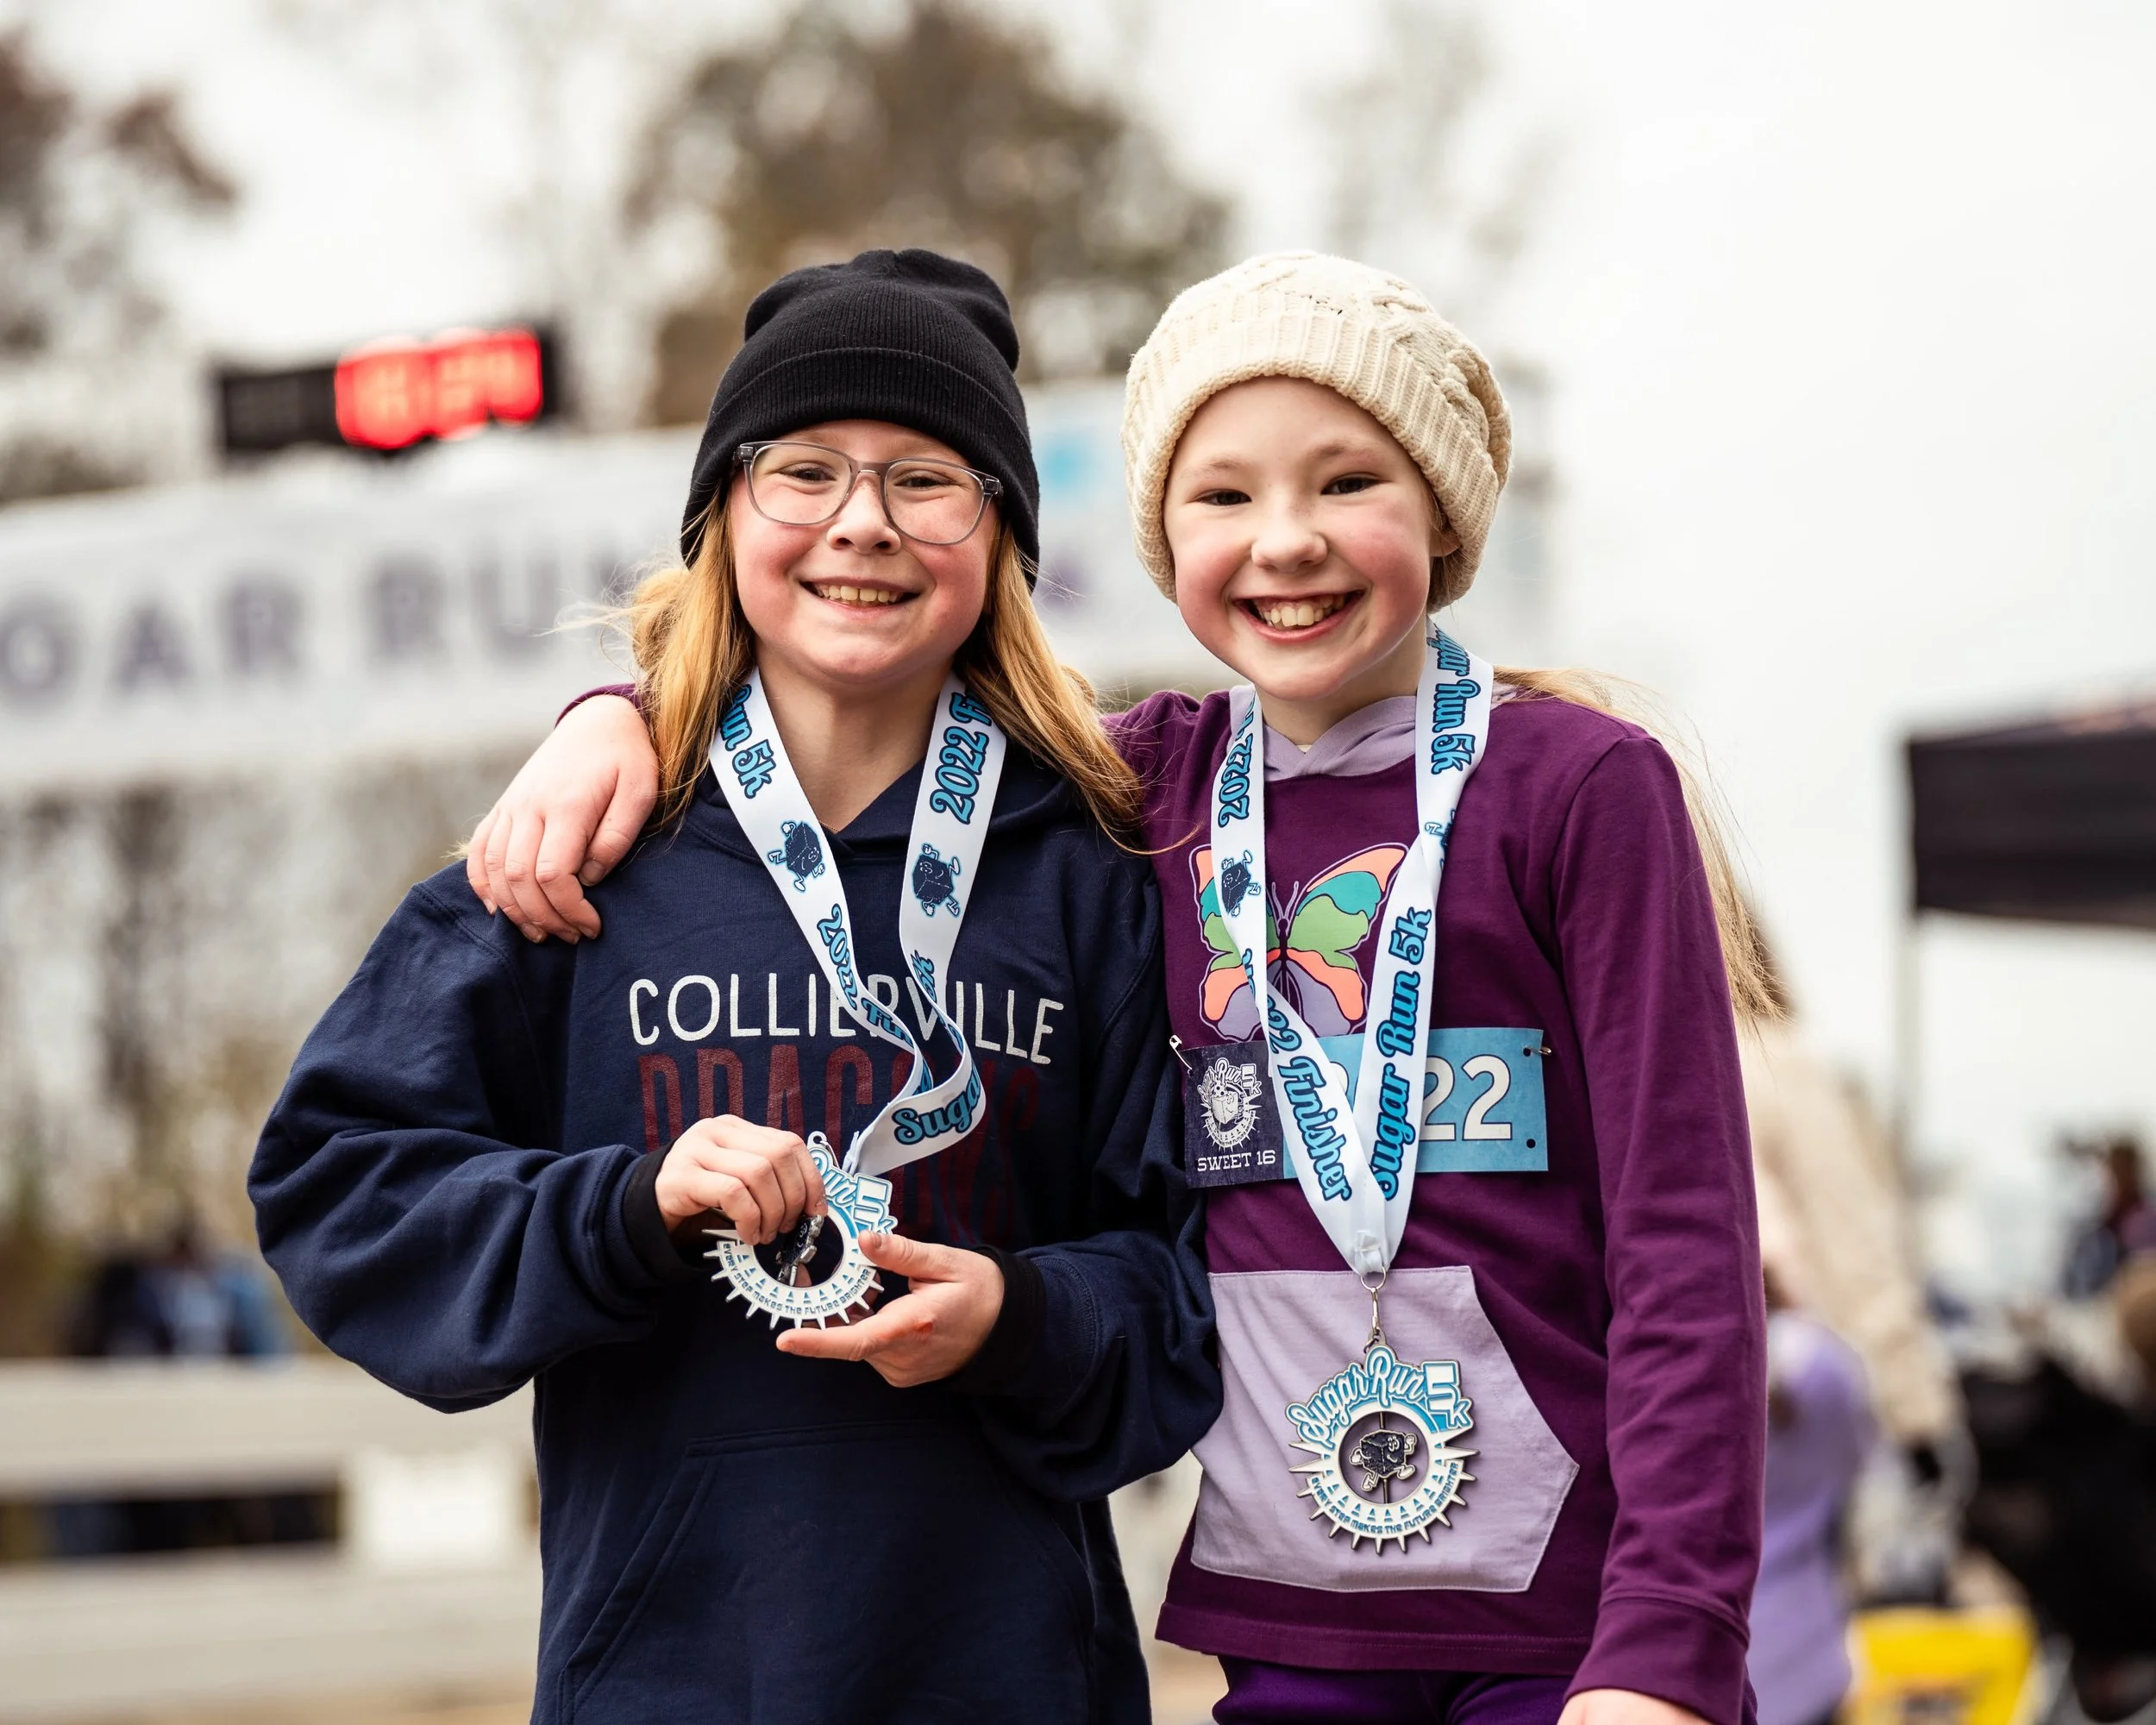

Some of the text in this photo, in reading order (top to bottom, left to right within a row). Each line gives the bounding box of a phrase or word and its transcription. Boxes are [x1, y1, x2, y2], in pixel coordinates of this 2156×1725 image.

[1433, 680, 1482, 732] Run
[732, 739, 776, 799] 5k
[930, 725, 990, 825] 2022
[1218, 733, 1254, 828] 2022
[1431, 733, 1476, 775] 5k
[817, 903, 858, 1011] 2022
[1331, 1054, 1514, 1141] 22
[1369, 906, 1432, 1201] Sugar Run 5k
[891, 1060, 981, 1145] Suga
[1277, 1055, 1352, 1201] Finisher
[1197, 1150, 1275, 1171] SWEET 16
[1286, 1363, 1370, 1451] Sugar
[1366, 1346, 1425, 1408] Run
